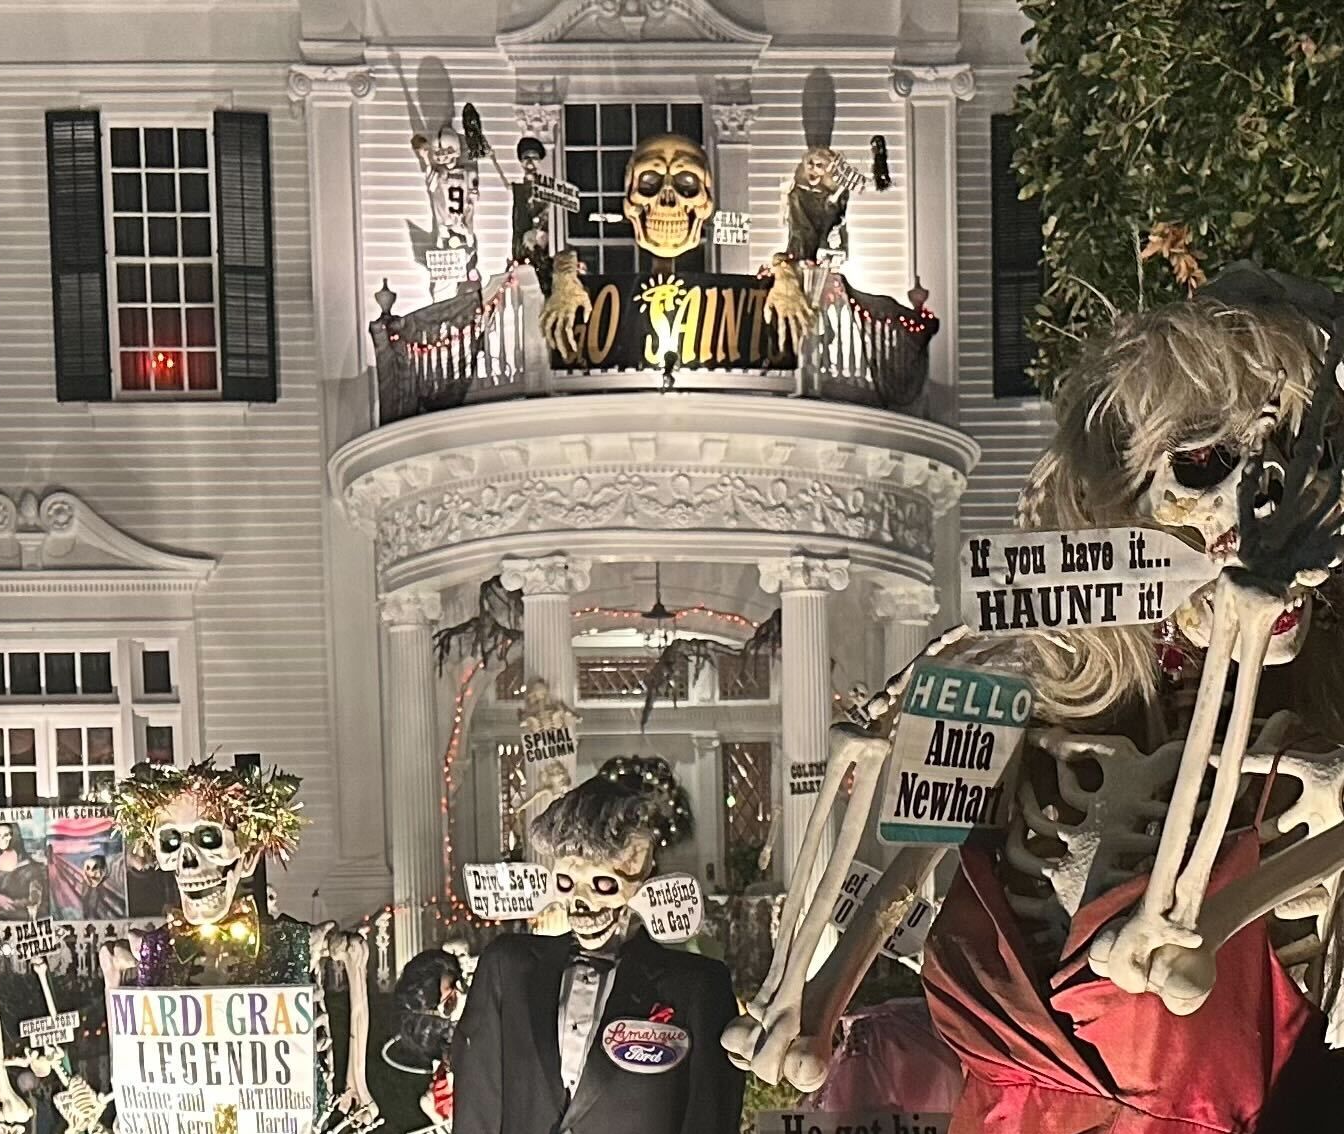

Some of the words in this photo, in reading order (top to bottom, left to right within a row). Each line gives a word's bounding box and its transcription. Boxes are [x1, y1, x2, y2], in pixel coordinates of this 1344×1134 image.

[448, 186, 464, 214] 9
[644, 284, 789, 366] SAINT
[969, 538, 991, 578] If
[1004, 544, 1045, 585] you
[1060, 534, 1114, 573] have
[1128, 531, 1171, 570] it...
[977, 582, 1123, 632] HAUNT
[1137, 581, 1164, 621] it!
[911, 673, 1033, 723] HELLO
[523, 727, 573, 750] SPINAL
[525, 742, 576, 763] COLUMN
[924, 720, 995, 771] Anita
[893, 771, 1005, 825] Newhart
[473, 896, 489, 917] my
[16, 919, 53, 941] DEATH
[651, 914, 665, 936] da
[16, 937, 58, 961] SPIRAL
[112, 993, 216, 1037] MARDI
[225, 991, 313, 1037] GRAS
[605, 1021, 688, 1045] Lamarque
[136, 1039, 292, 1086] LEGENDS
[624, 1045, 664, 1063] Ford
[121, 1084, 173, 1110] Blaine
[177, 1087, 206, 1114] and
[237, 1086, 312, 1111] ARTHURitis
